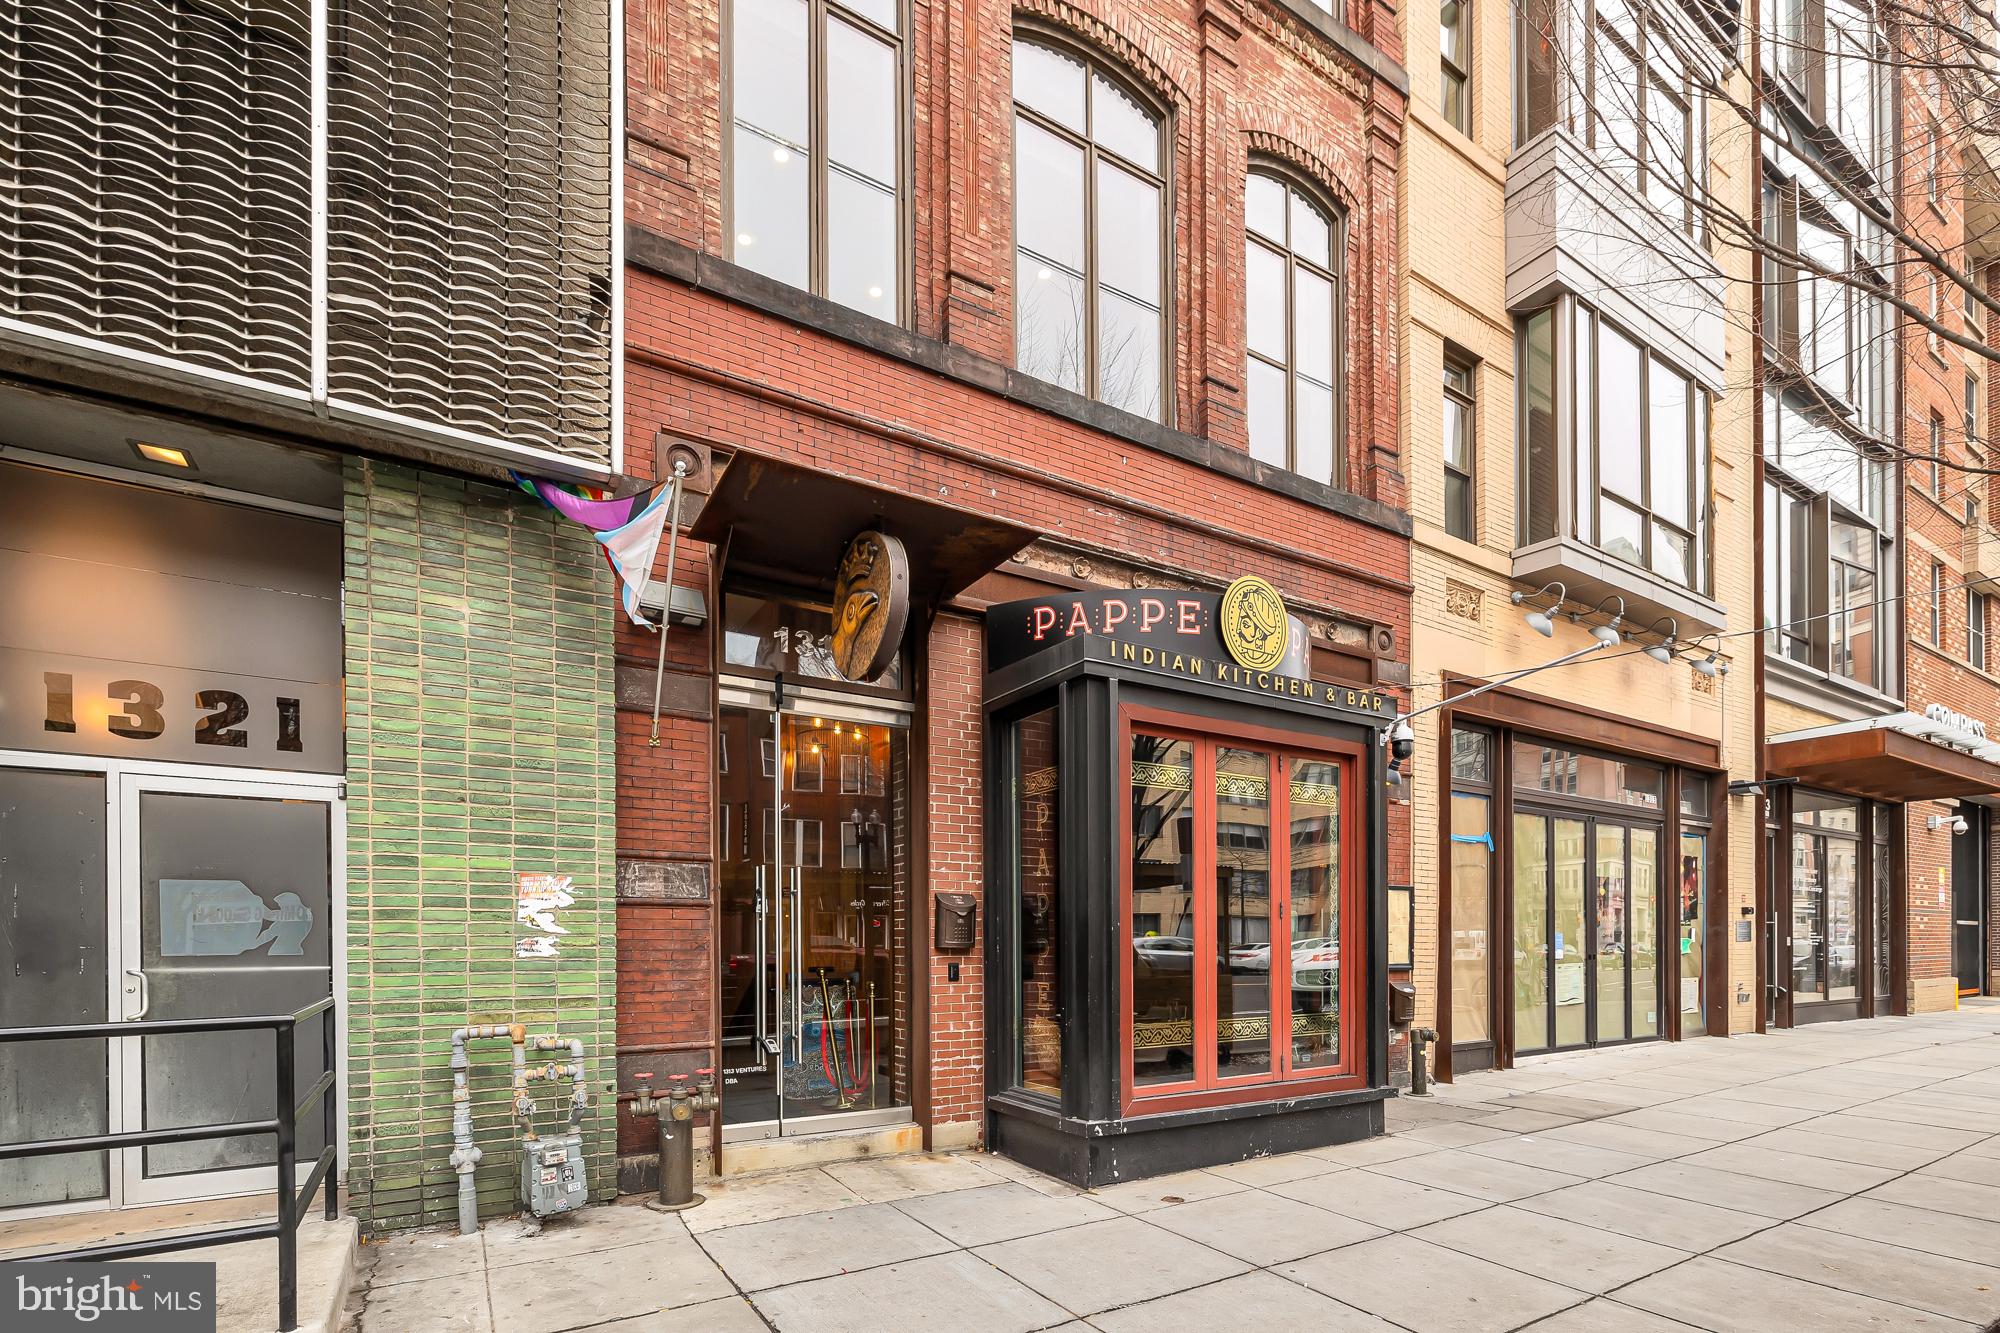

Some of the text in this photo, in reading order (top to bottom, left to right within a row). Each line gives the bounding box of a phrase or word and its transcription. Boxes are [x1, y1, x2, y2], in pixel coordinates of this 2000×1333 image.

[1033, 598, 1201, 641] PAPPE
[1110, 640, 1383, 711] INDIAN KITCHEN & BAR
[43, 671, 303, 752] 1321
[1926, 703, 1985, 739] COMPASS
[735, 1066, 767, 1074] VENTURES
